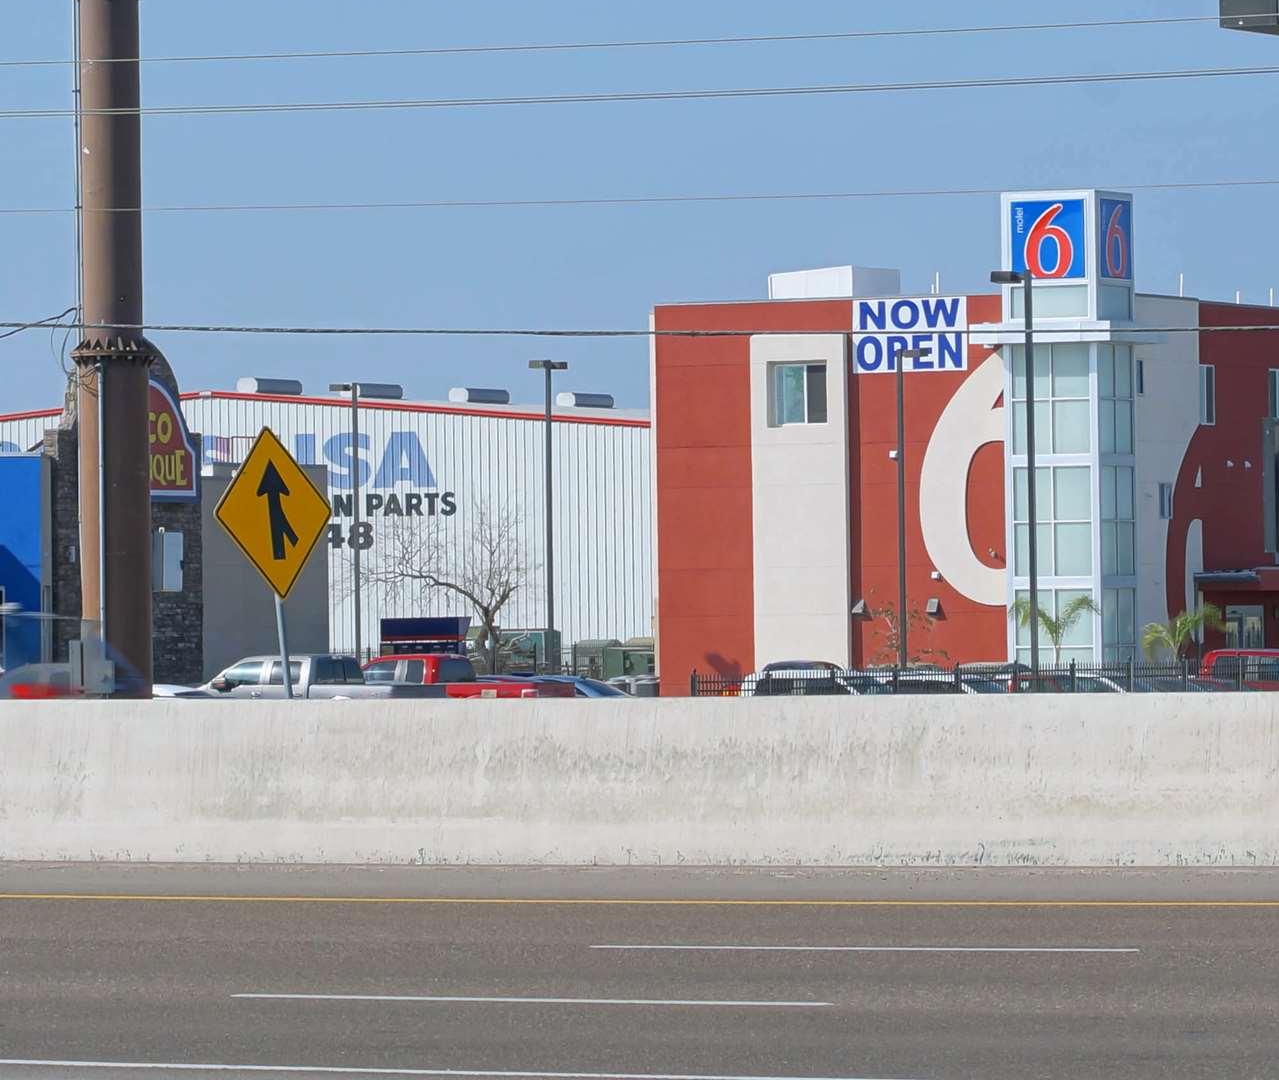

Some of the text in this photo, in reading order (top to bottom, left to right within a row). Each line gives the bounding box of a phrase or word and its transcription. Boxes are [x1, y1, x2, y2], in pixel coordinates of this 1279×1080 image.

[1015, 207, 1024, 234] motel
[1024, 203, 1073, 279] 6
[1106, 204, 1127, 279] 6
[859, 298, 960, 331] NOW
[856, 332, 963, 371] OPEN
[365, 491, 457, 517] PARTS
